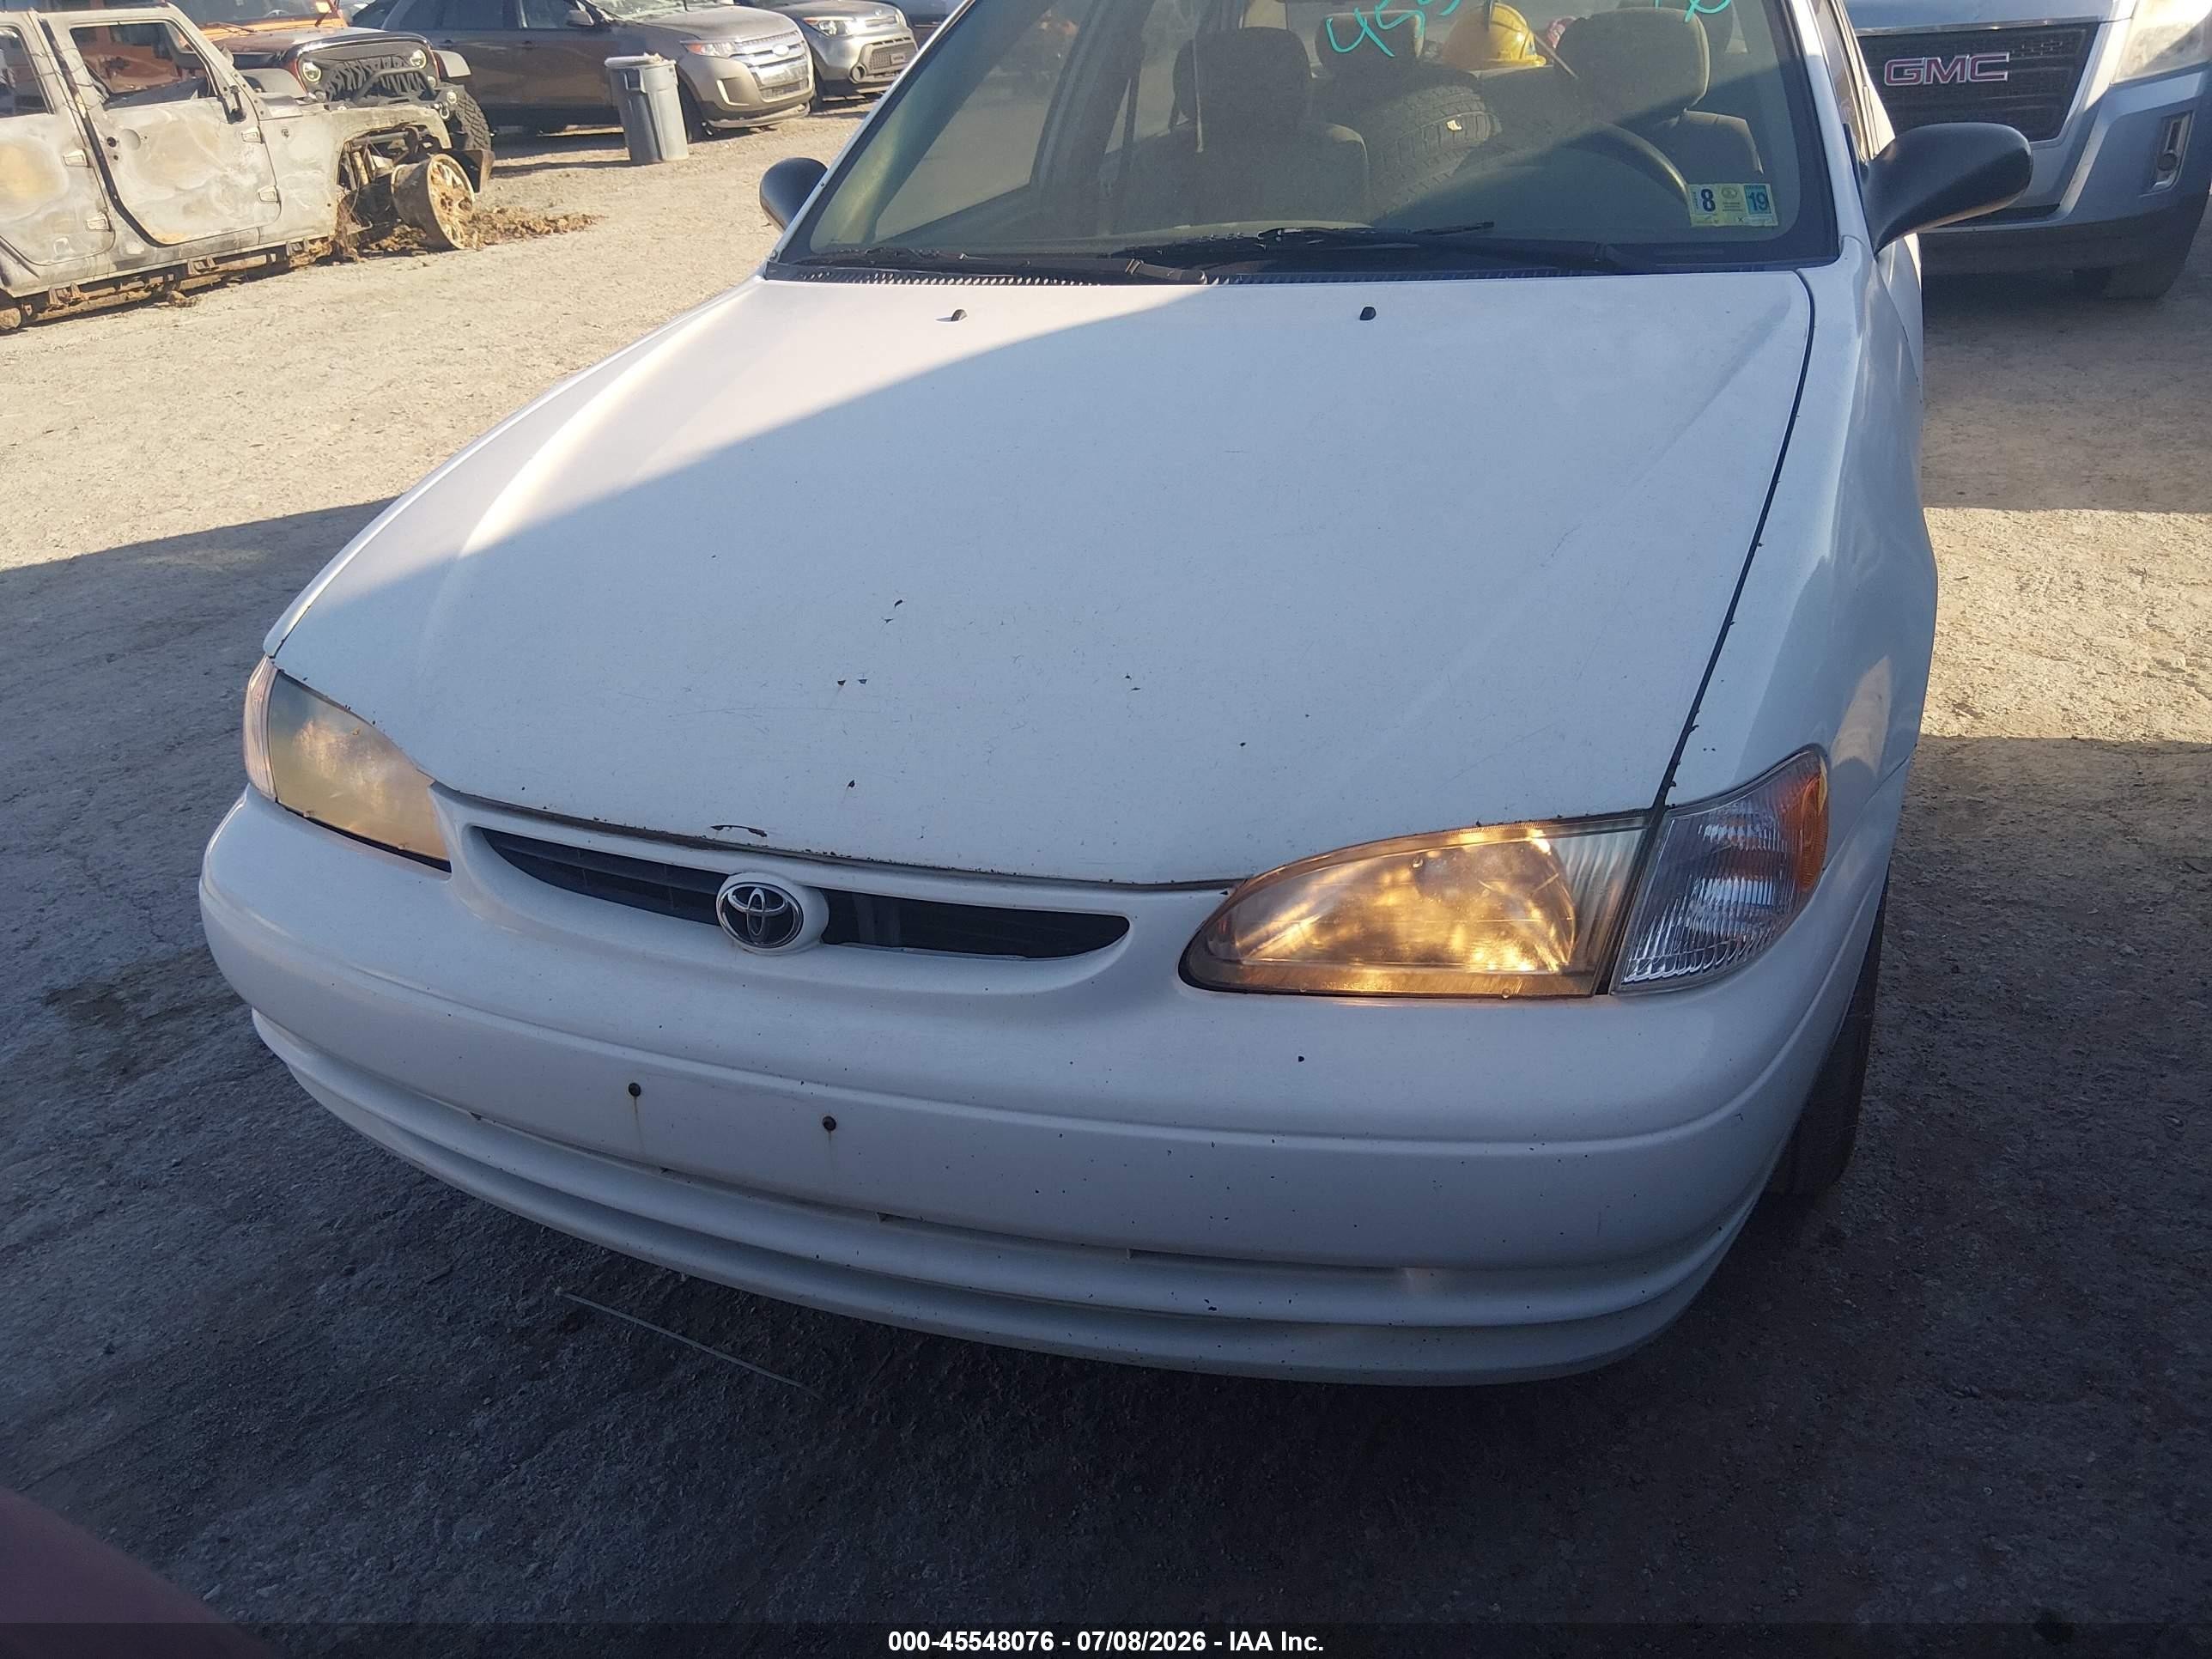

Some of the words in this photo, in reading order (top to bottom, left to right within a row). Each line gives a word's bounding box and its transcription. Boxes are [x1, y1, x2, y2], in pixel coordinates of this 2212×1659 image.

[1884, 52, 2010, 86] GMC
[1700, 188, 1717, 212] 8
[1747, 191, 1770, 211] 19
